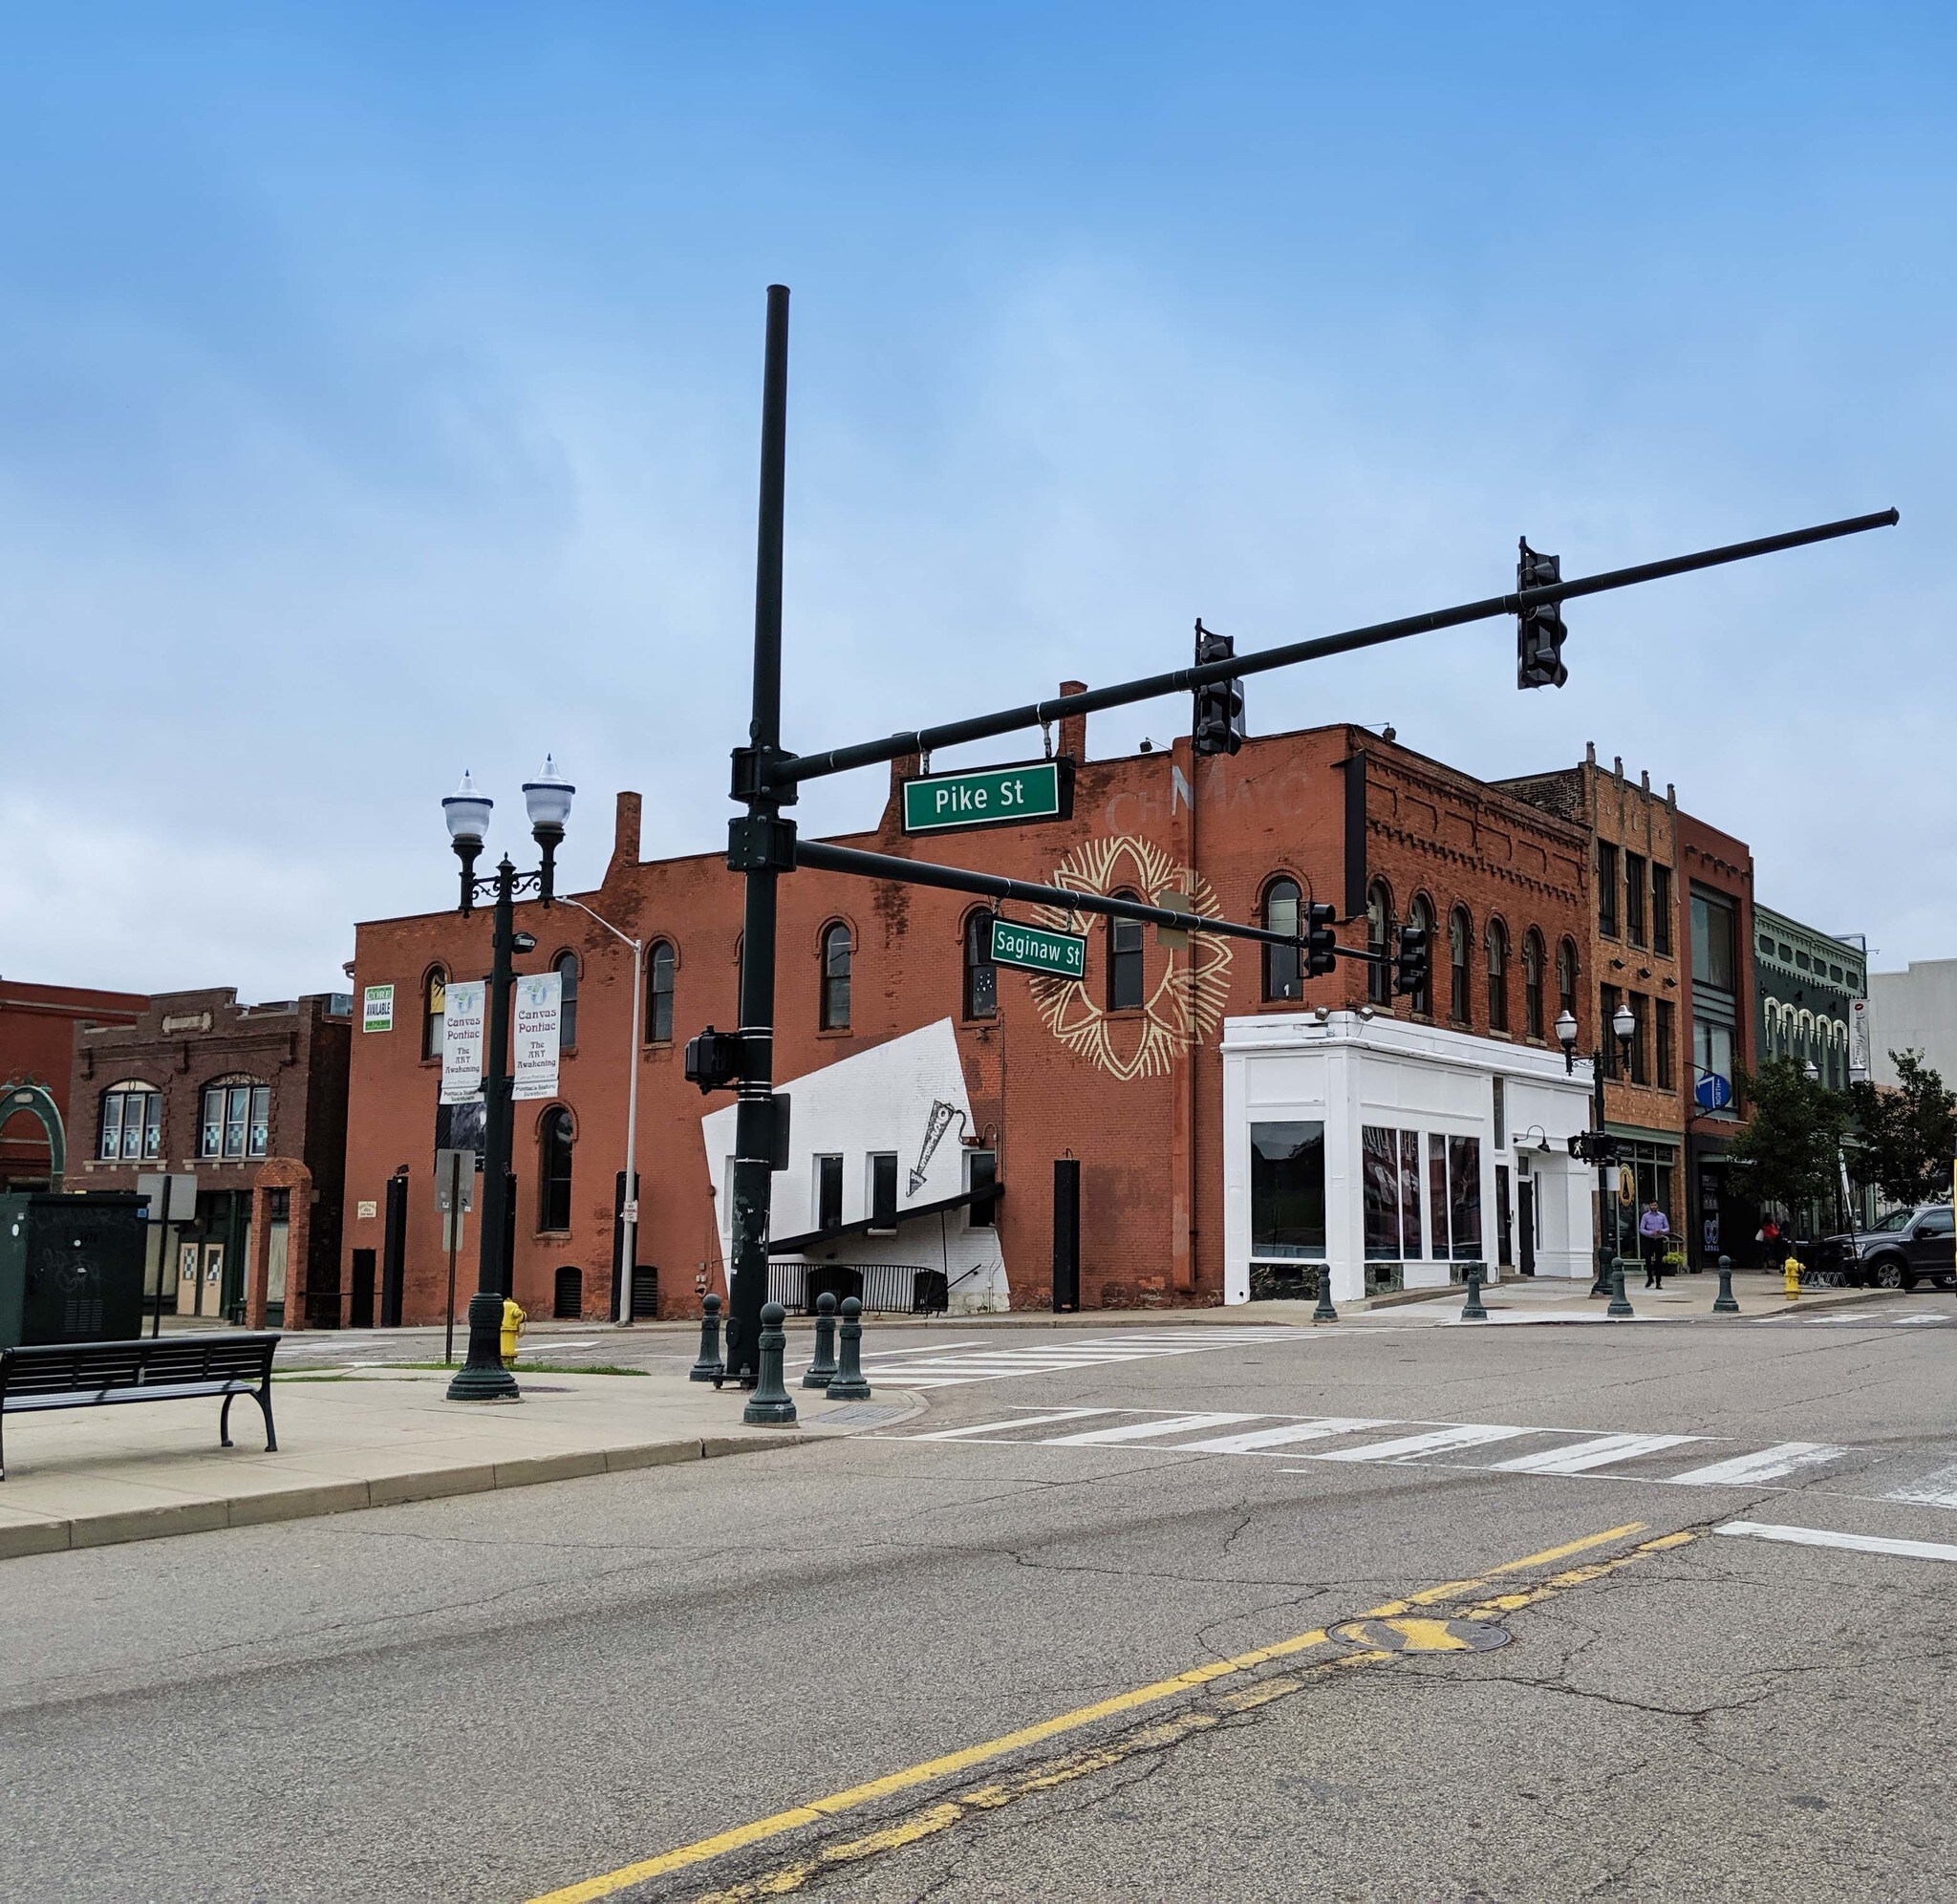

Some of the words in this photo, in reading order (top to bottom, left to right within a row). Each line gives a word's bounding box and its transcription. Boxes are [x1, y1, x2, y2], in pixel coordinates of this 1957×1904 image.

[935, 785, 988, 813] Pike
[1000, 780, 1024, 805] St
[997, 931, 1061, 961] Saginaw
[1066, 946, 1081, 966] St
[367, 990, 391, 1000] CORE
[518, 1009, 557, 1019] Canvas
[447, 1017, 481, 1027] Canvas
[519, 1022, 556, 1033] Pontiac
[447, 1030, 480, 1040] Pontiac
[528, 1050, 546, 1059] ART
